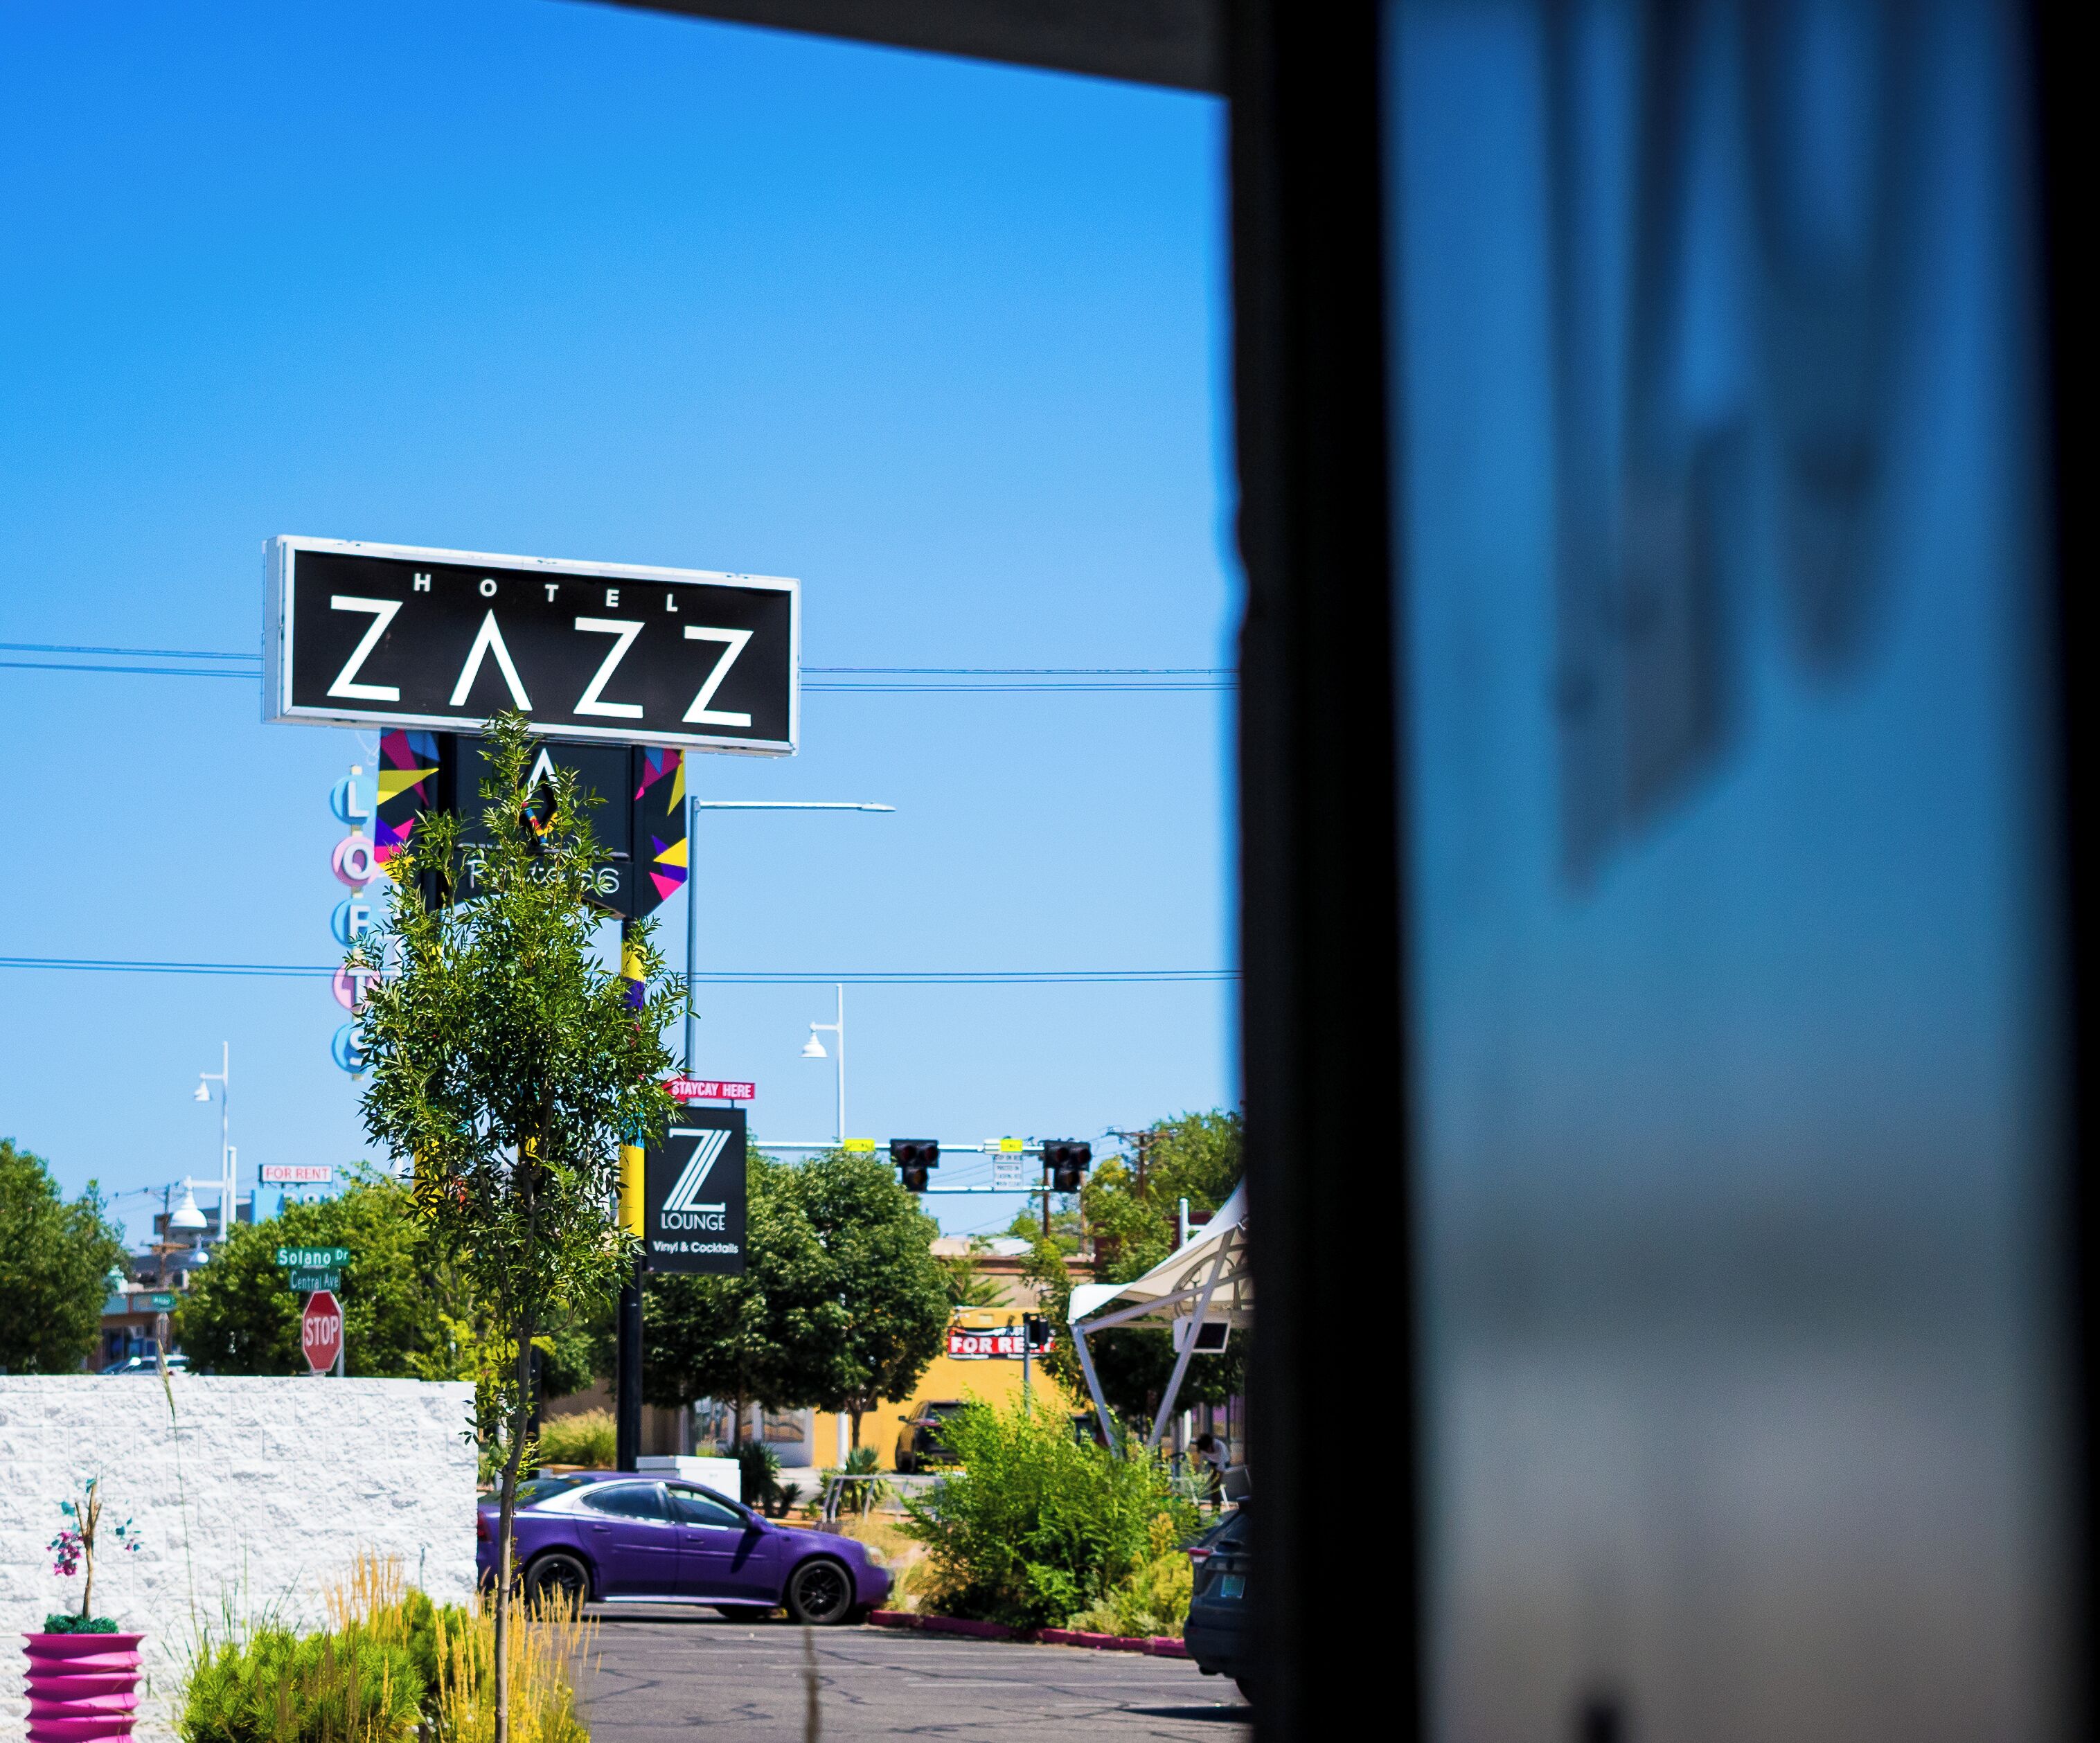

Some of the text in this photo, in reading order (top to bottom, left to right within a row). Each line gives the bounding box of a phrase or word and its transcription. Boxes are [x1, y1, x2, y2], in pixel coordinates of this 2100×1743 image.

[414, 573, 677, 612] HOTEL
[327, 595, 754, 727] ZAZZ
[342, 780, 380, 1065] LOFTS
[671, 1080, 751, 1098] STAYCAY HERE
[265, 1167, 329, 1180] FOR RENT
[663, 1127, 731, 1212] Z
[661, 1213, 726, 1231] LOUNGE
[652, 1240, 739, 1254] Vinyl & Cocktails
[278, 1249, 348, 1266] Solano Dr
[290, 1271, 339, 1290] Central Ave
[305, 1315, 339, 1347] STOP
[950, 1337, 1053, 1353] FOR RET
